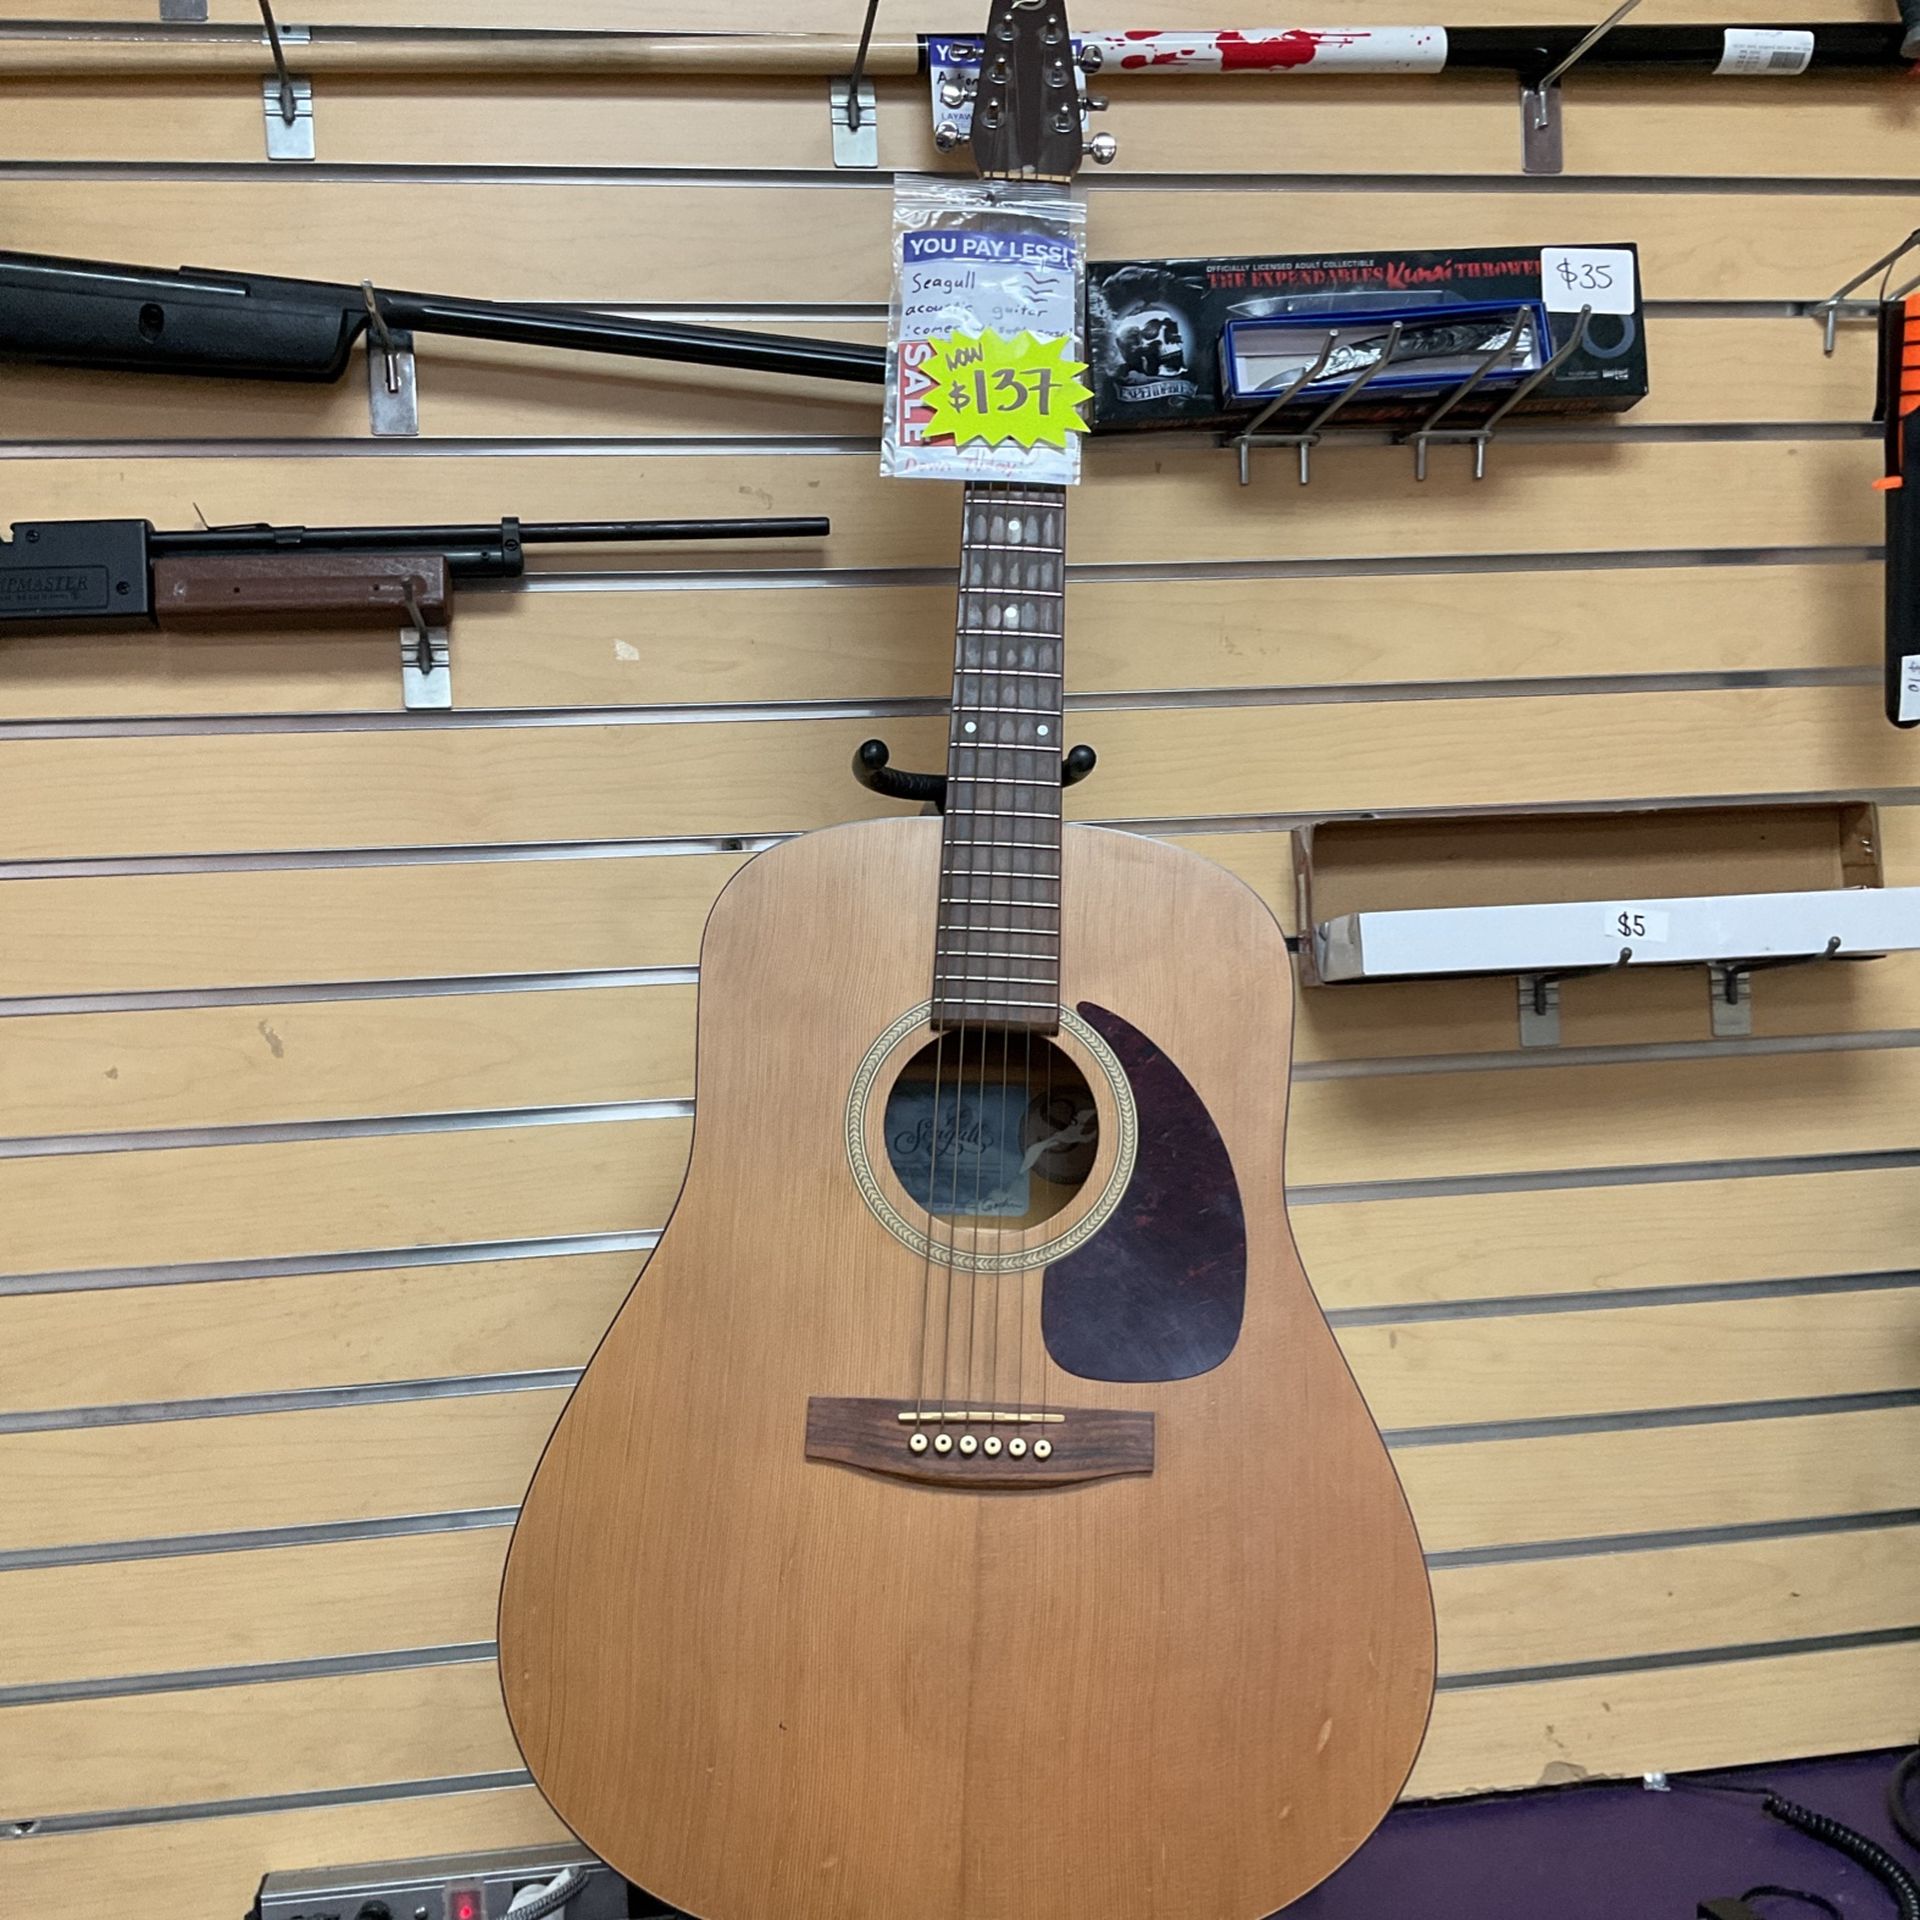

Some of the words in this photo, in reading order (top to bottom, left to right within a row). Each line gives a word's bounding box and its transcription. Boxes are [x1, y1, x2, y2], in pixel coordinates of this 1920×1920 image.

[910, 238, 956, 256] YOU
[963, 240, 1004, 258] PAY
[1010, 242, 1068, 262] LESS!
[1206, 264, 1249, 273] OFFICIALLY
[1252, 262, 1292, 271] LICENSED
[1295, 261, 1320, 270] ADULT
[1323, 259, 1374, 268] COLLECTIBLE
[1207, 271, 1246, 289] THE
[1251, 267, 1384, 288] EXPENDABLES
[1556, 257, 1613, 290] $35
[912, 271, 976, 294] Seagull
[992, 304, 1048, 320] guitar
[904, 344, 932, 443] SALE
[948, 368, 1063, 416] $137
[1617, 911, 1645, 936] $5
